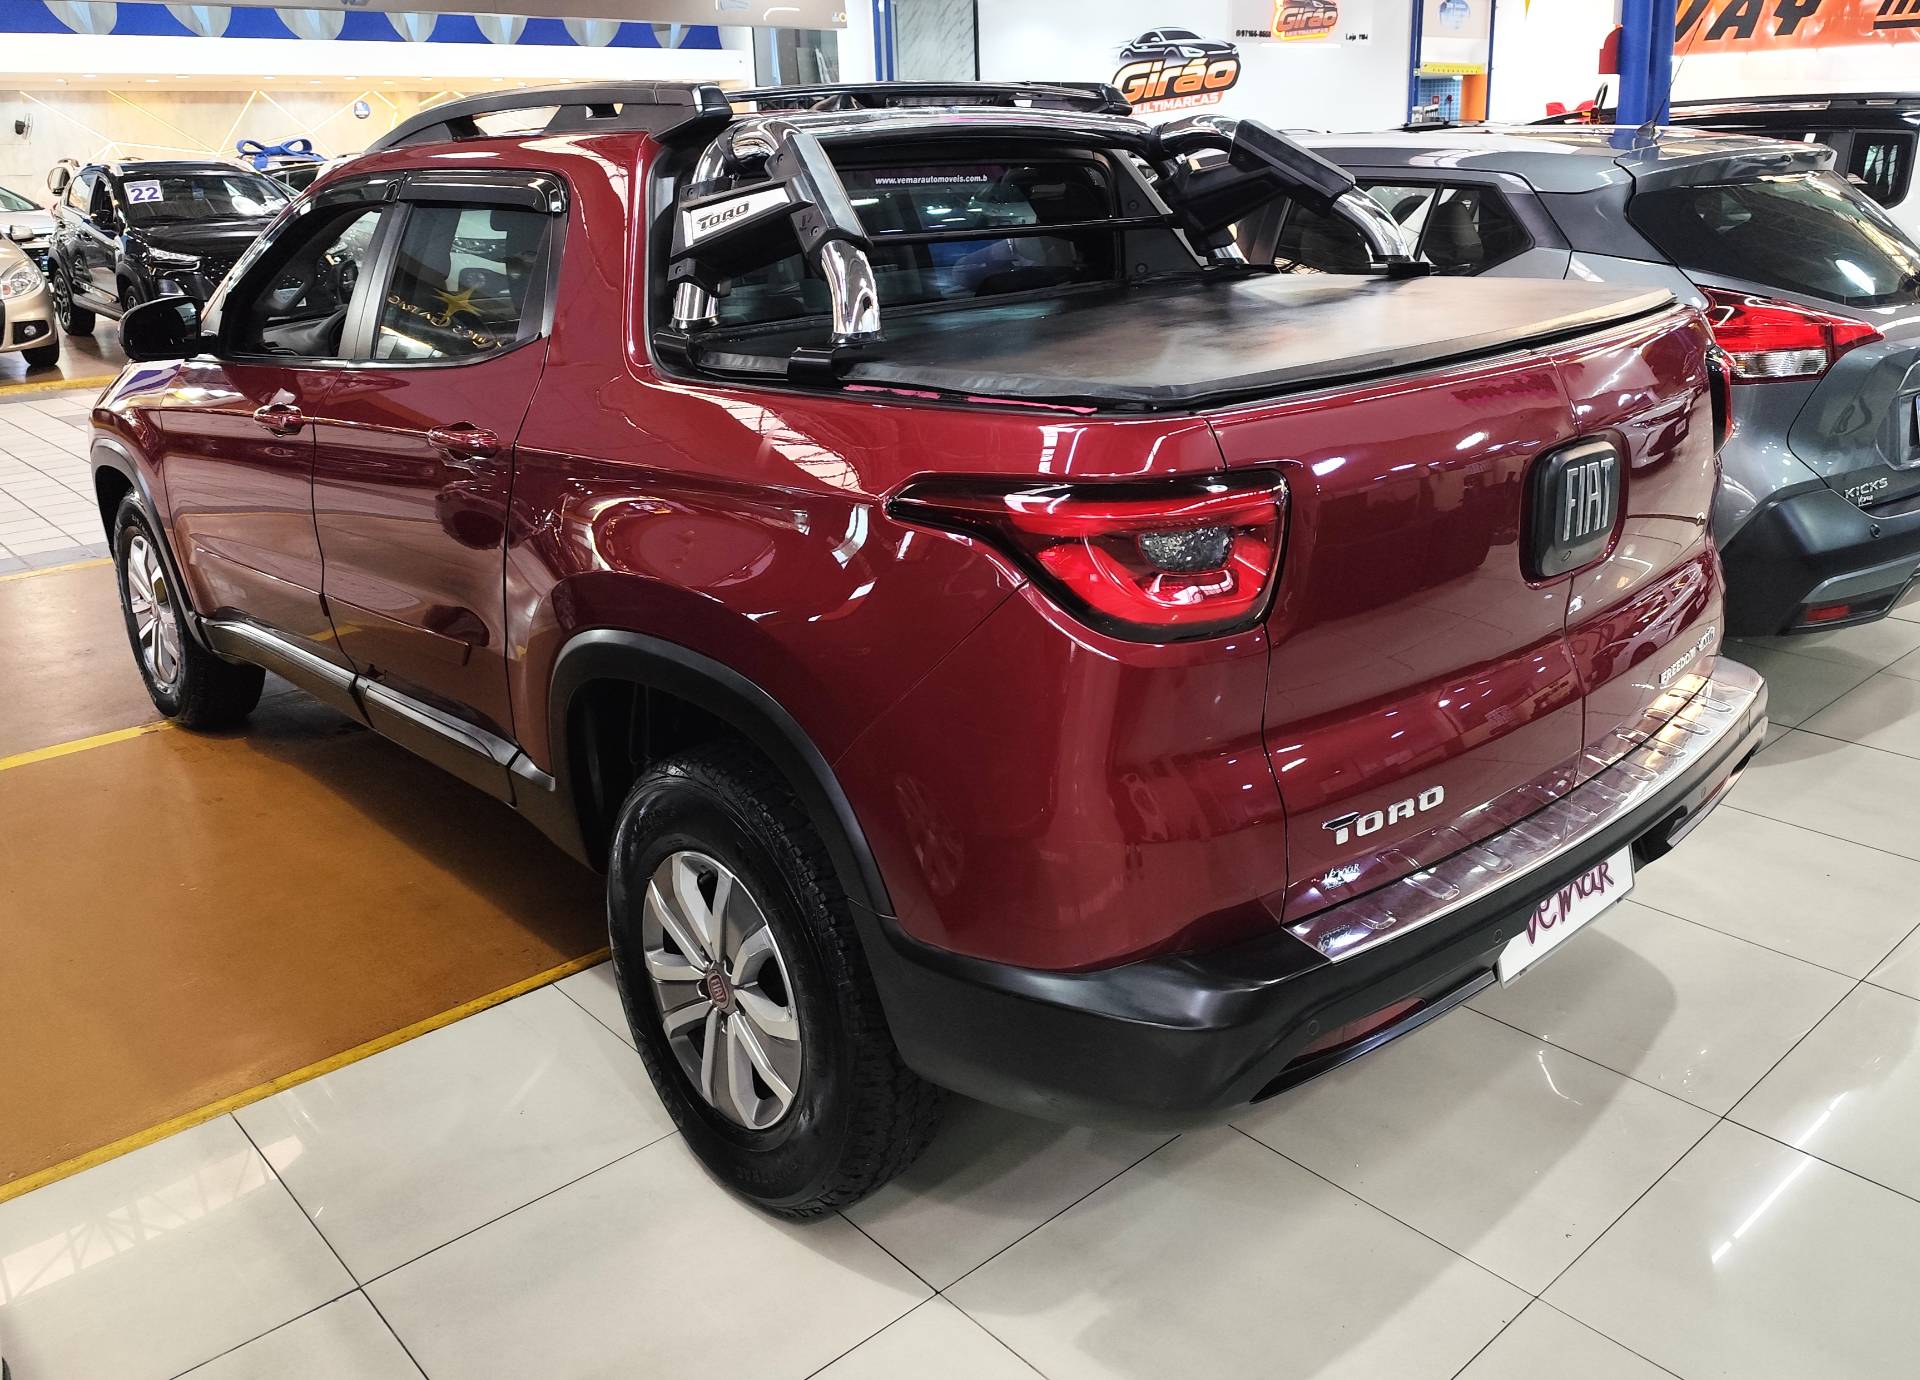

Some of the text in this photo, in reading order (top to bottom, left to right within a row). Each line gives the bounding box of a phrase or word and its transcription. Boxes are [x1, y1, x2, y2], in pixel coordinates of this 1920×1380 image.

[130, 187, 160, 202] 22
[698, 202, 750, 231] TORO
[1563, 457, 1615, 541] FIAT
[1845, 477, 1888, 499] KICKS
[1322, 785, 1445, 846] TORO
